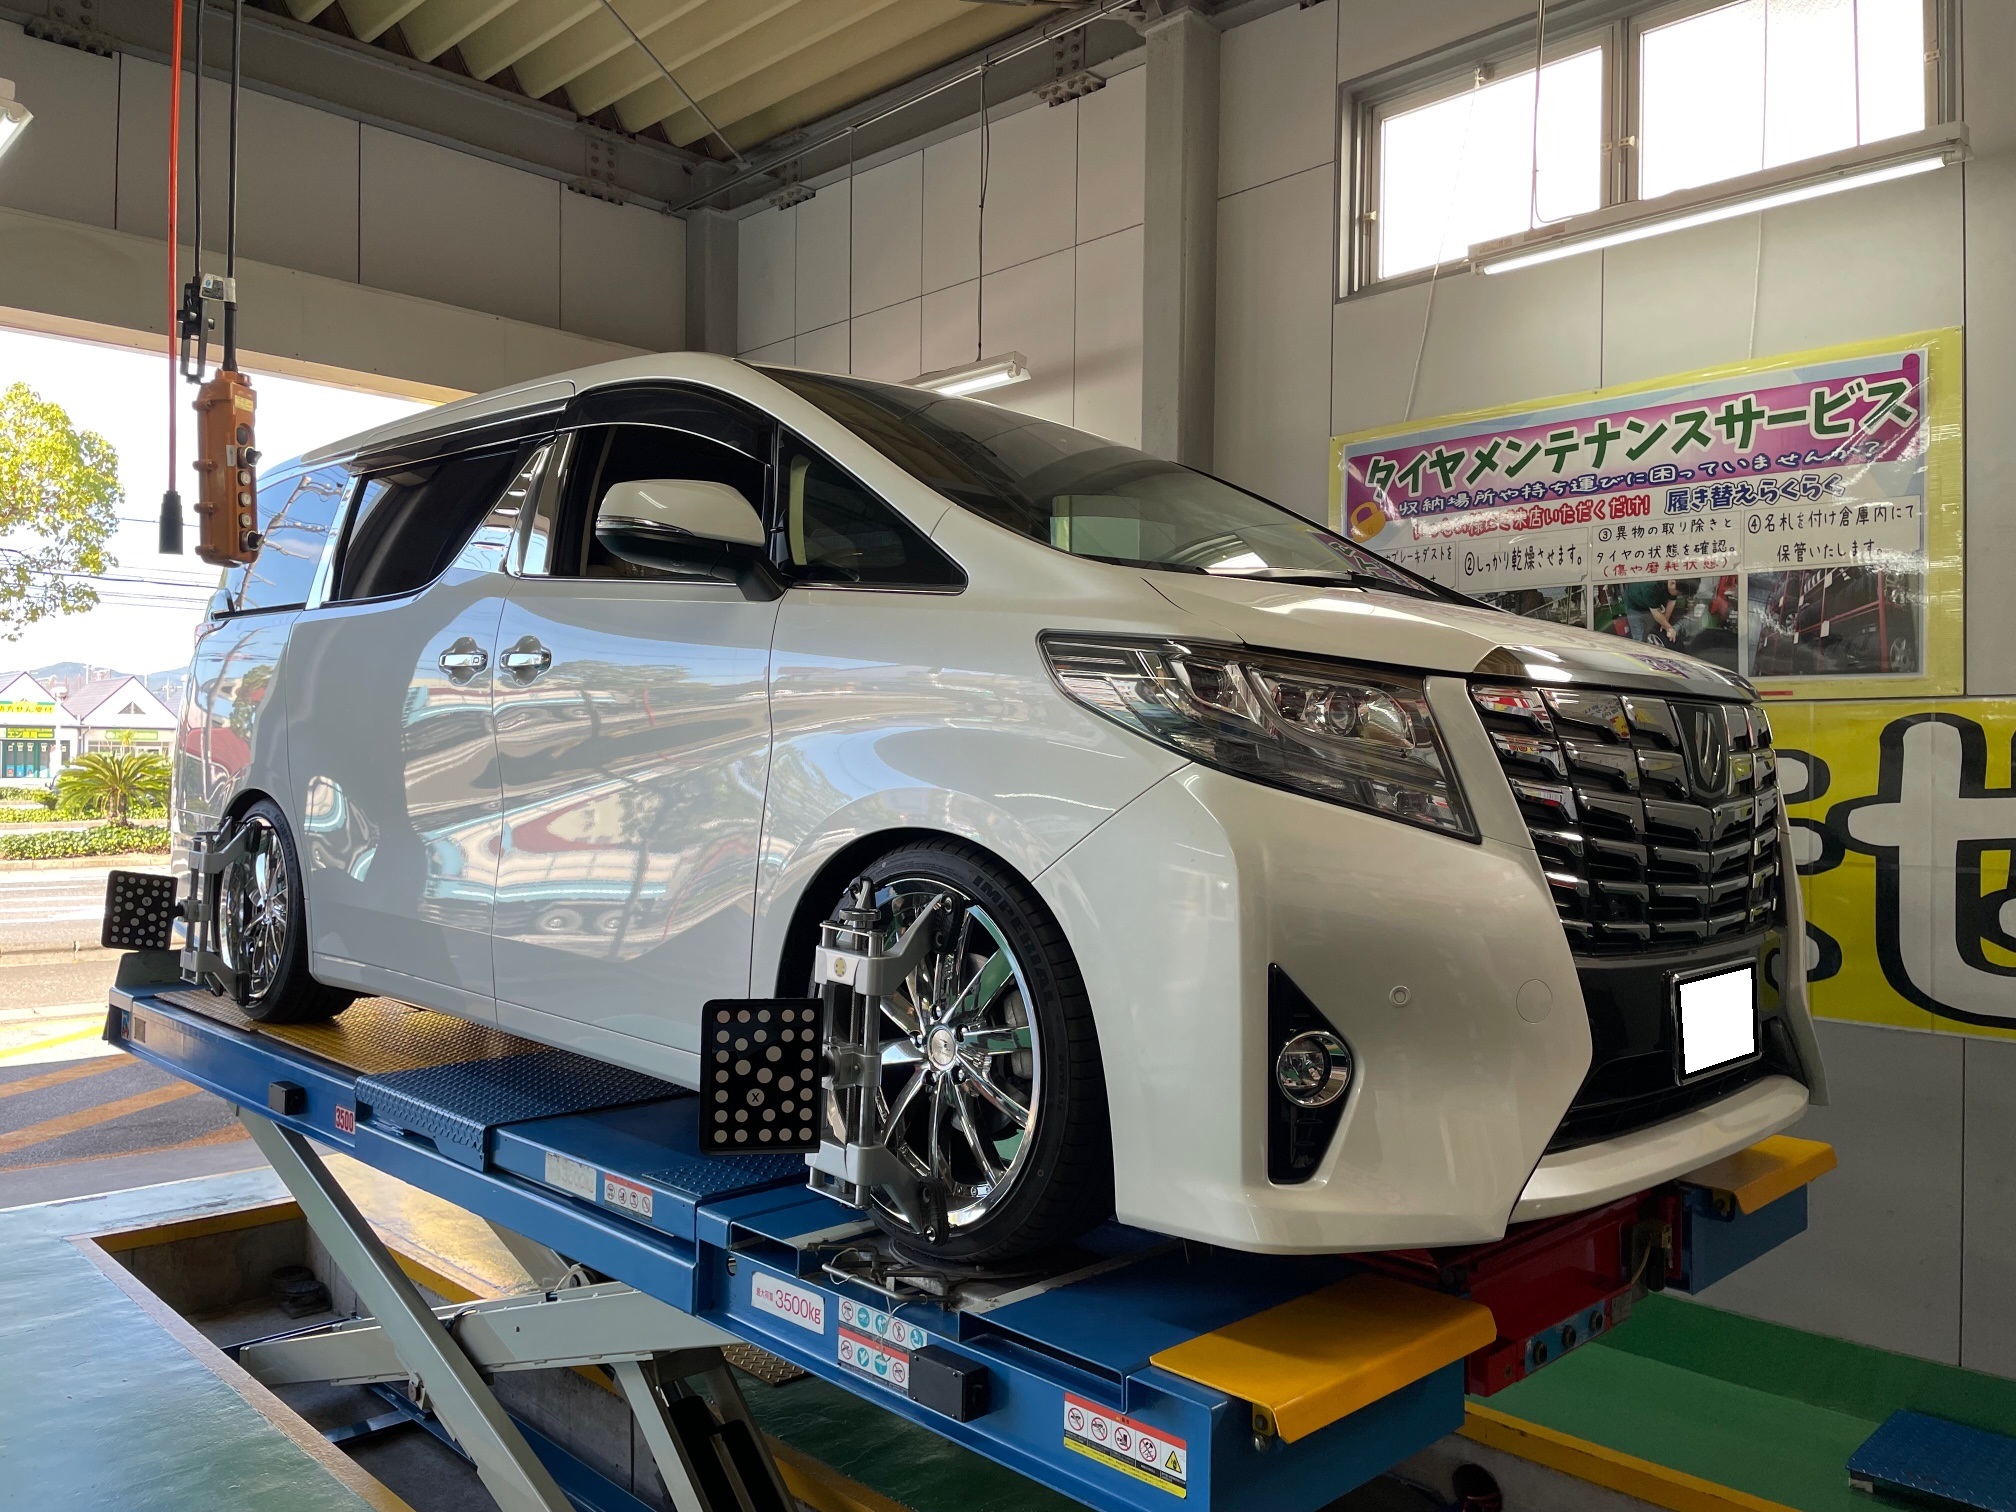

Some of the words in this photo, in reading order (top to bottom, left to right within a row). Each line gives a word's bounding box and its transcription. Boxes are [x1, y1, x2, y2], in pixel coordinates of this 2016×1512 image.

[1366, 380, 1917, 500] タイヤメンテナンスサービス
[1664, 473, 1847, 516] 履き替えらくらく
[1598, 517, 1733, 543] ③異物の取り除きと
[1464, 544, 1583, 577] ②しっかり乾燥させます。
[1596, 540, 1737, 564] タイヤの状態を確認。
[1777, 537, 1883, 562] 保管いたします。
[972, 875, 1055, 1003] IMPERIAL
[336, 1106, 354, 1133] 3500
[775, 1289, 821, 1325] 3500kg
